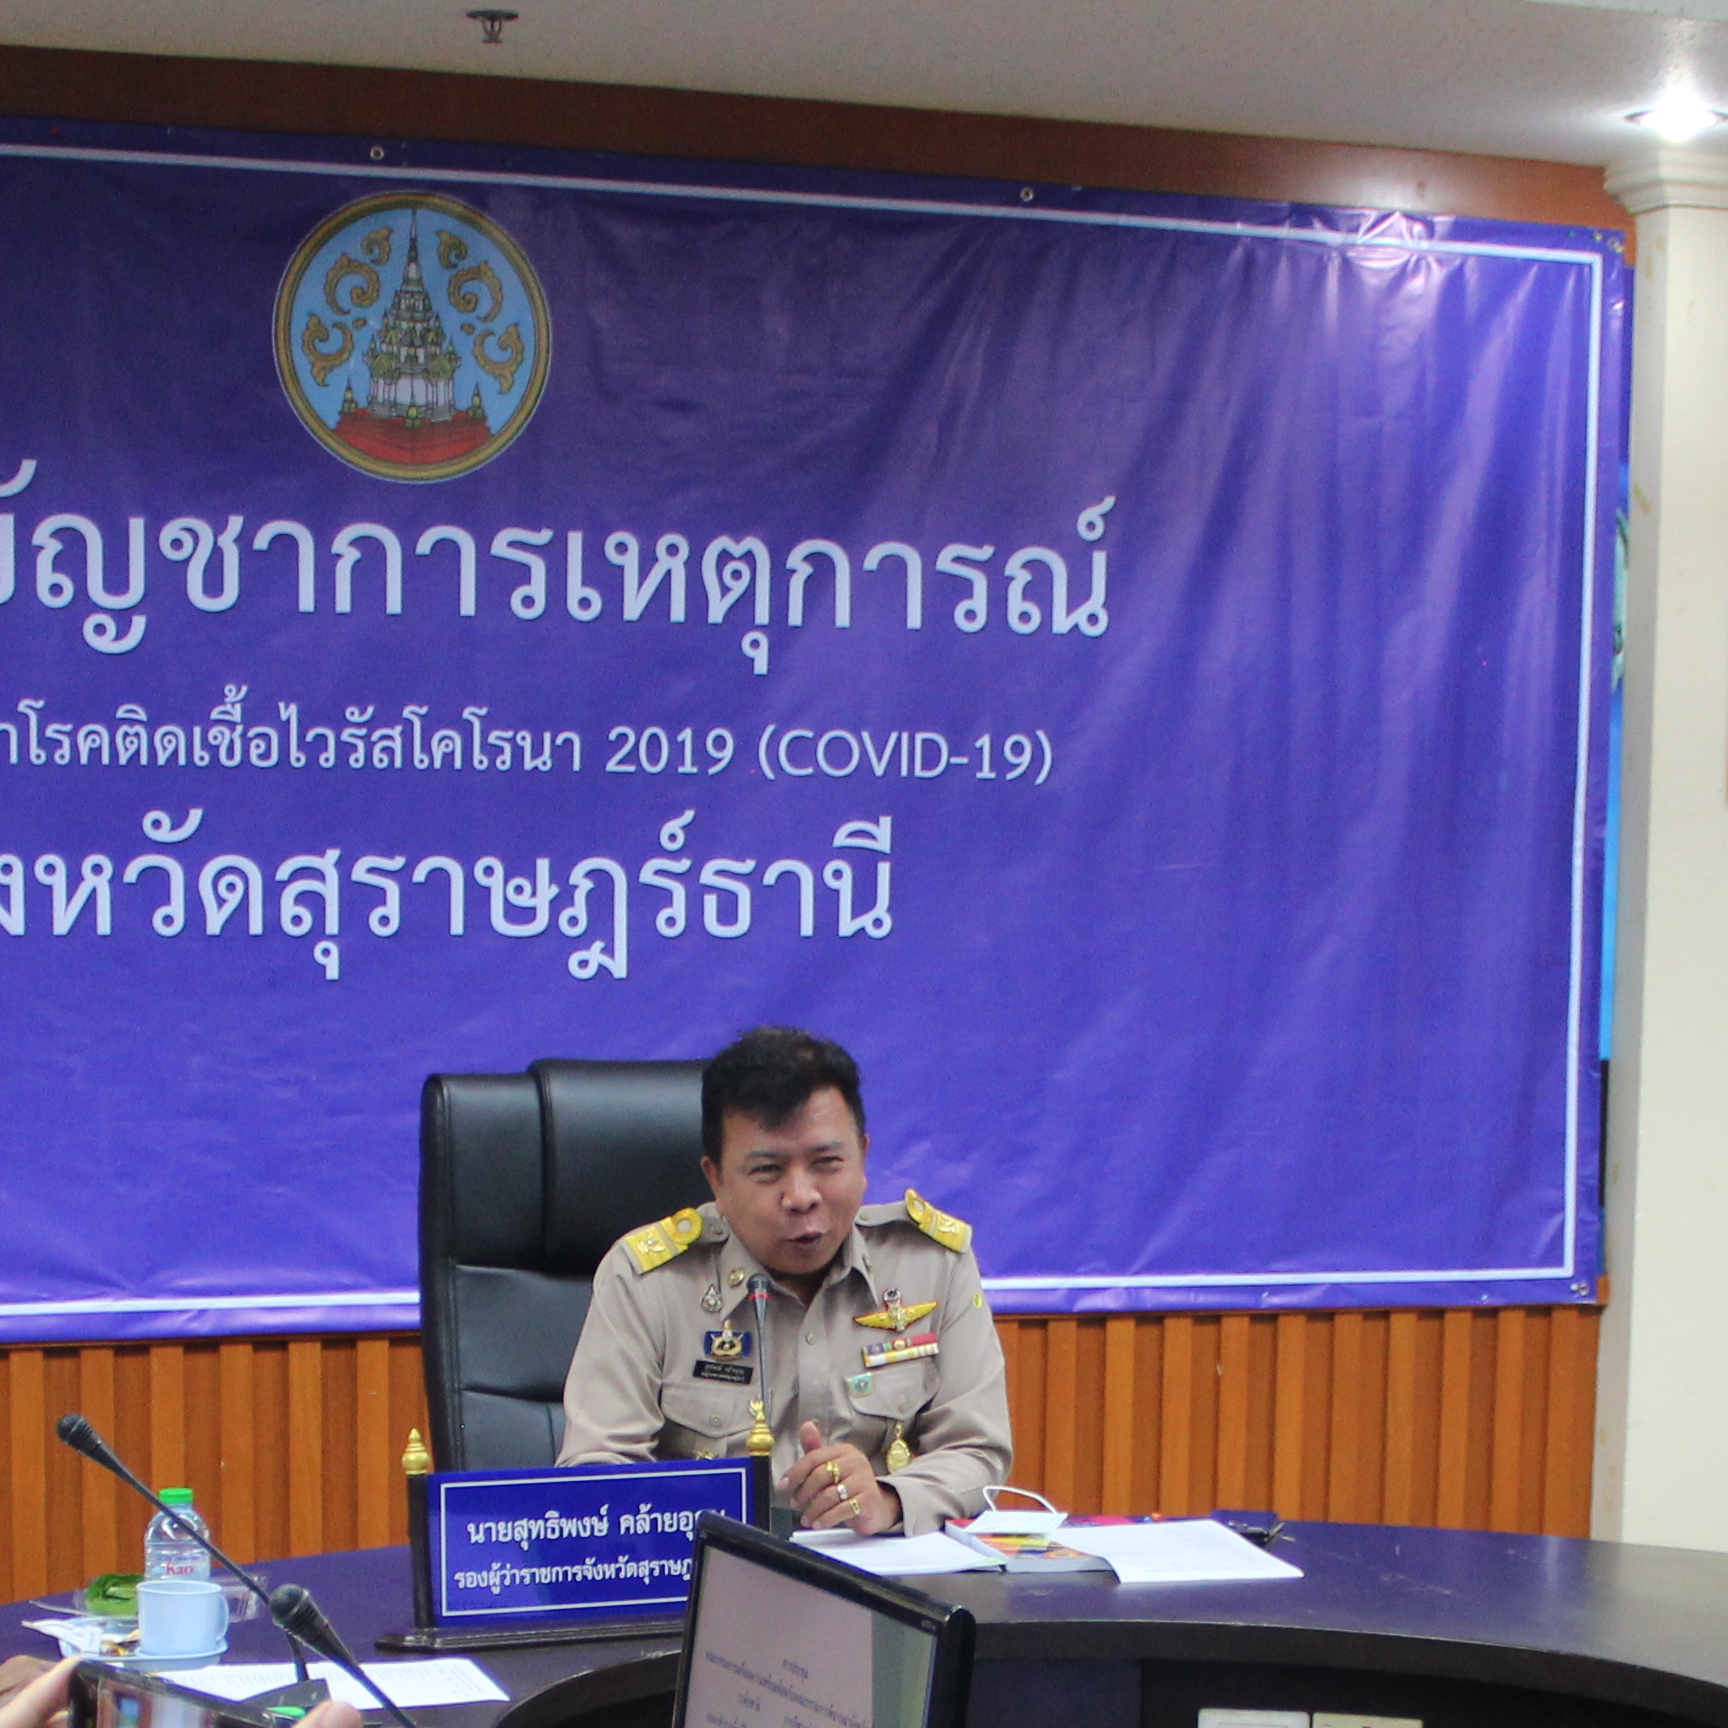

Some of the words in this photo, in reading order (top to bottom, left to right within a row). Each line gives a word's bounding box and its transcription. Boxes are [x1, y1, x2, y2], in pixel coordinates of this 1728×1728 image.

[604, 726, 735, 775] 2019
[757, 724, 1054, 785] (COVID-19)
[467, 1503, 610, 1551] นายสุทธิพงษ์
[619, 1503, 726, 1541] คล้ายอุ
